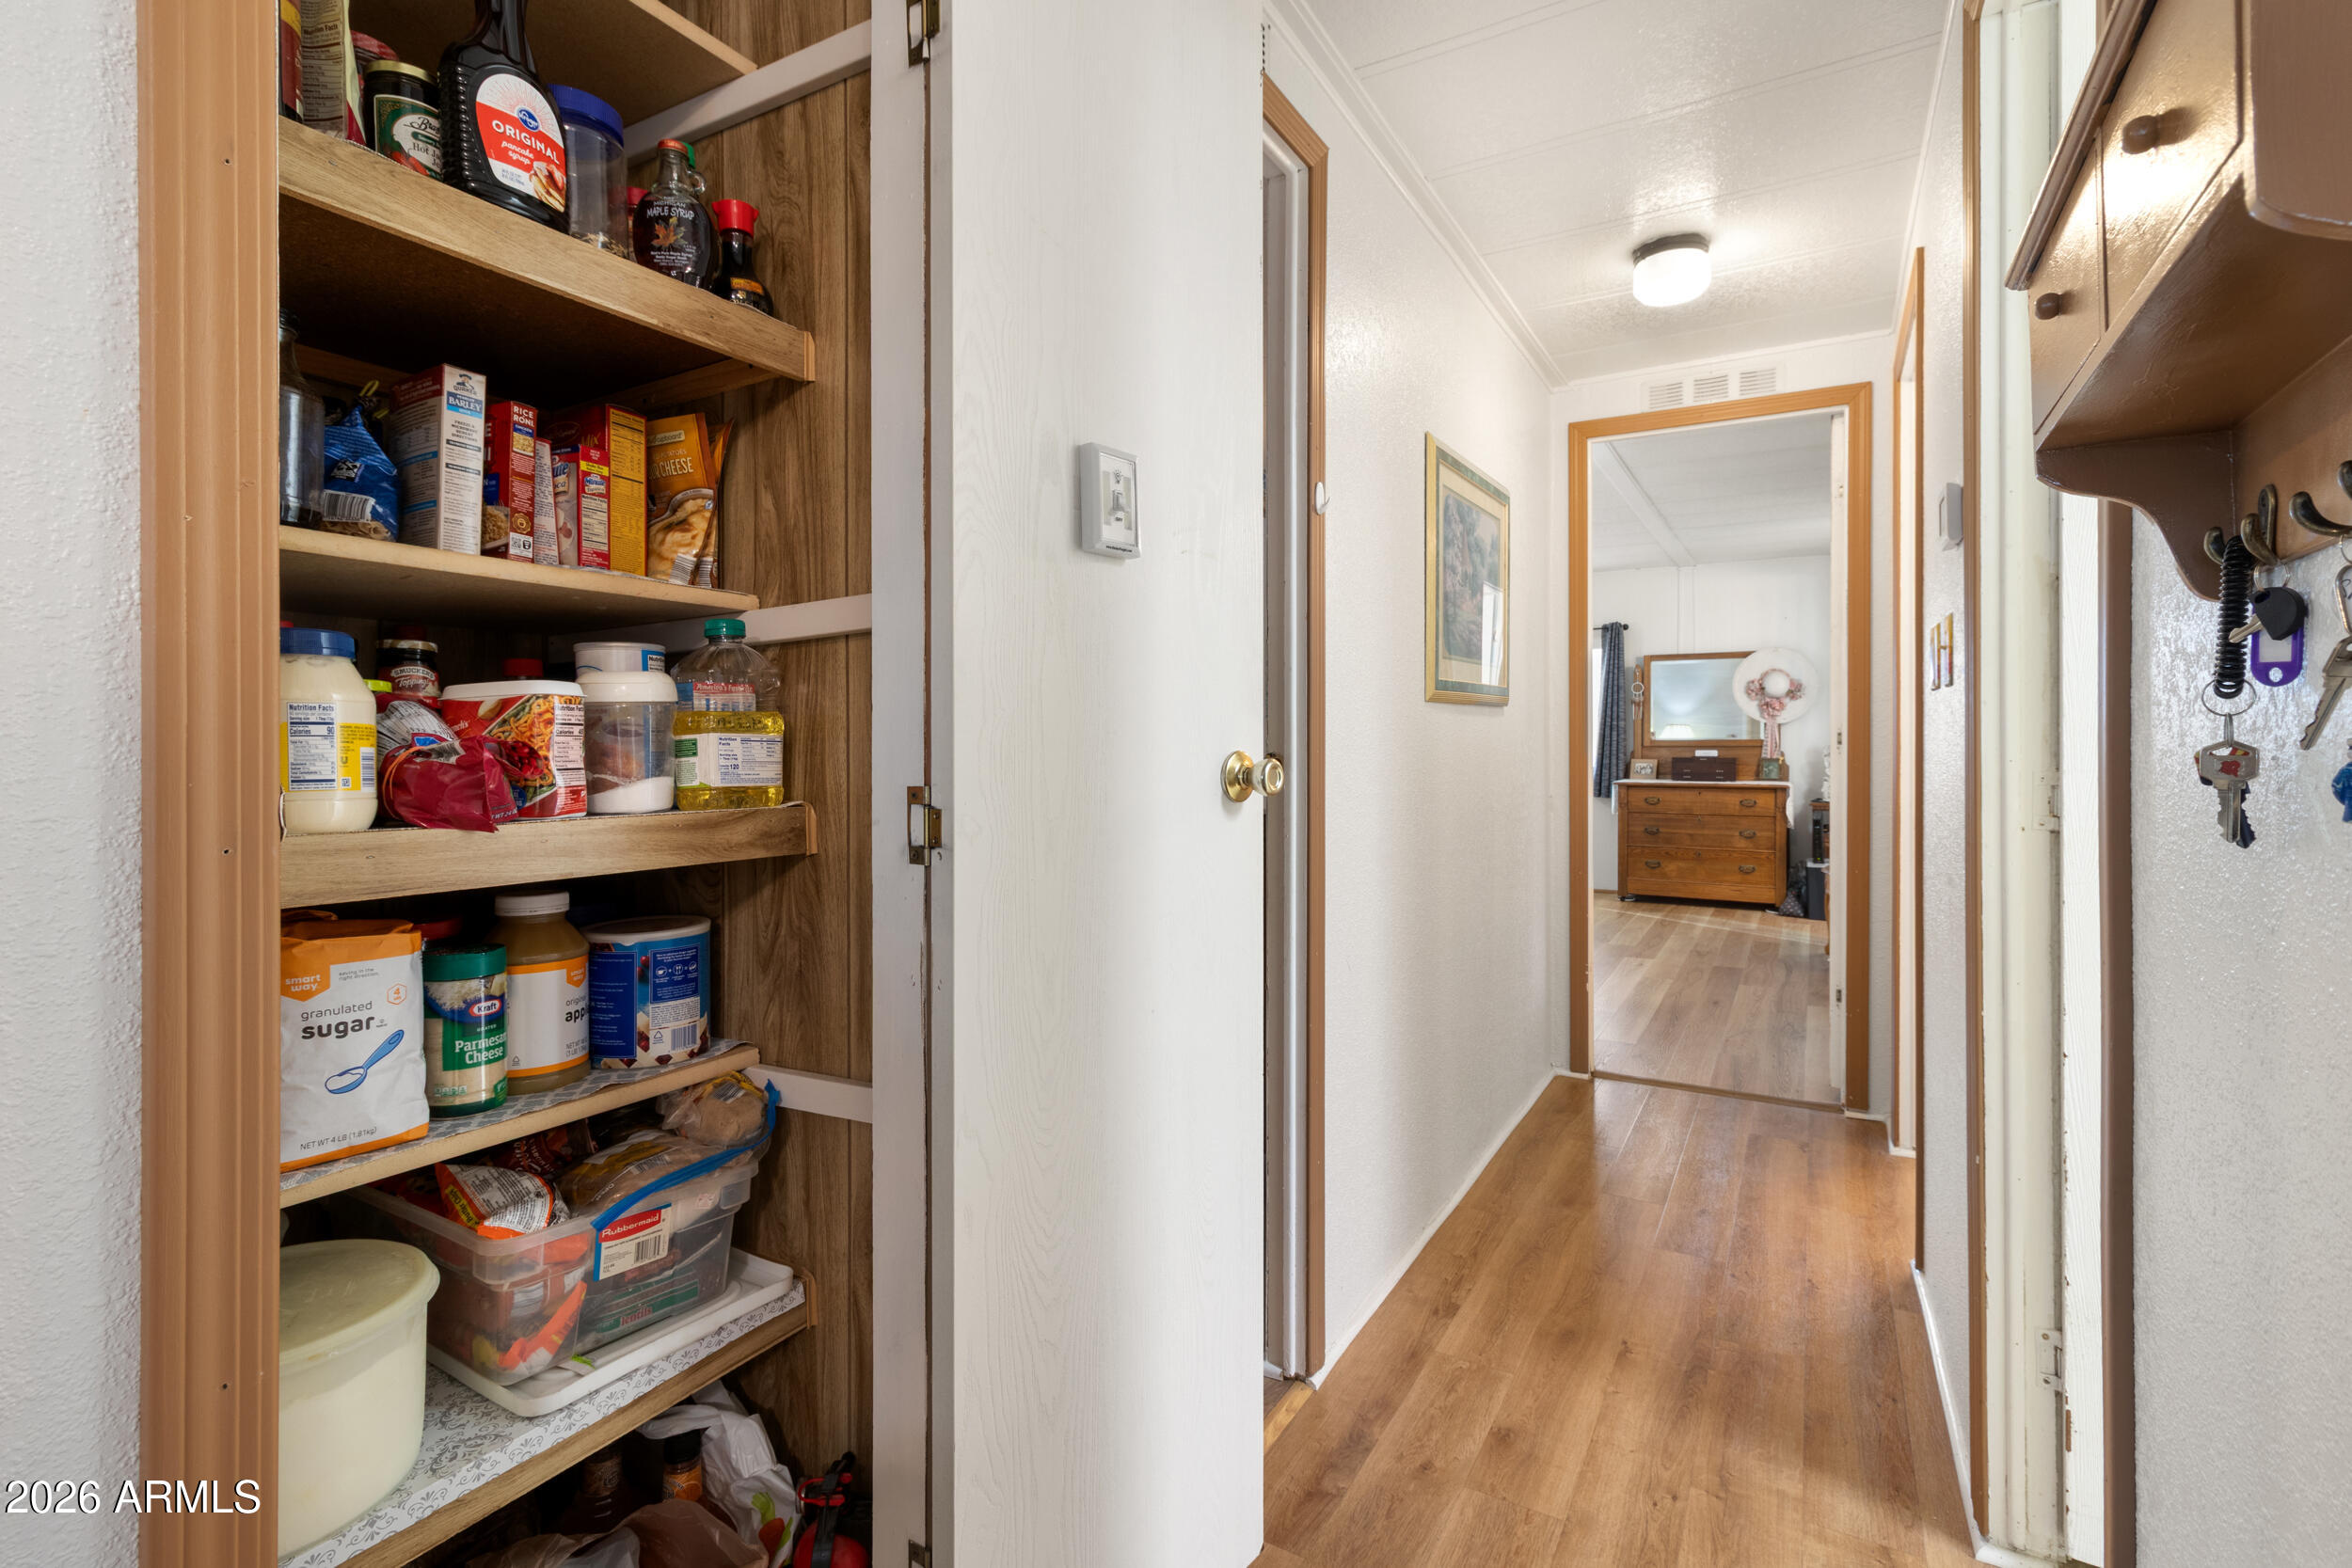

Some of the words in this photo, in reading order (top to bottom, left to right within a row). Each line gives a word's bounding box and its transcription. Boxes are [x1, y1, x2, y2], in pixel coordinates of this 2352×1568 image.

[412, 142, 430, 155] Hot
[492, 119, 560, 165] ORIGINAL
[501, 140, 534, 159] pancake
[508, 150, 532, 165] syrup
[653, 200, 686, 209] MICHIGAN
[646, 206, 669, 218] MAPLE
[670, 207, 694, 220] SYRUP
[453, 385, 478, 396] QUAKER
[448, 396, 482, 412] BARLEY
[513, 405, 533, 419] RICE
[660, 457, 694, 477] CHEESE
[584, 477, 606, 486] Minute
[695, 683, 727, 691] America's
[326, 726, 334, 735] 90
[286, 974, 321, 985] smart
[291, 982, 318, 991] way
[301, 1001, 373, 1022] granulated
[477, 1002, 497, 1014] Kraft
[301, 1016, 375, 1039] sugar
[465, 1046, 503, 1064] Cheese
[300, 1140, 316, 1149] NET
[317, 1137, 330, 1147] WT
[348, 1127, 377, 1140] (1.81kg)
[601, 1212, 660, 1238] Rubbermaid
[620, 1307, 653, 1326] lentils
